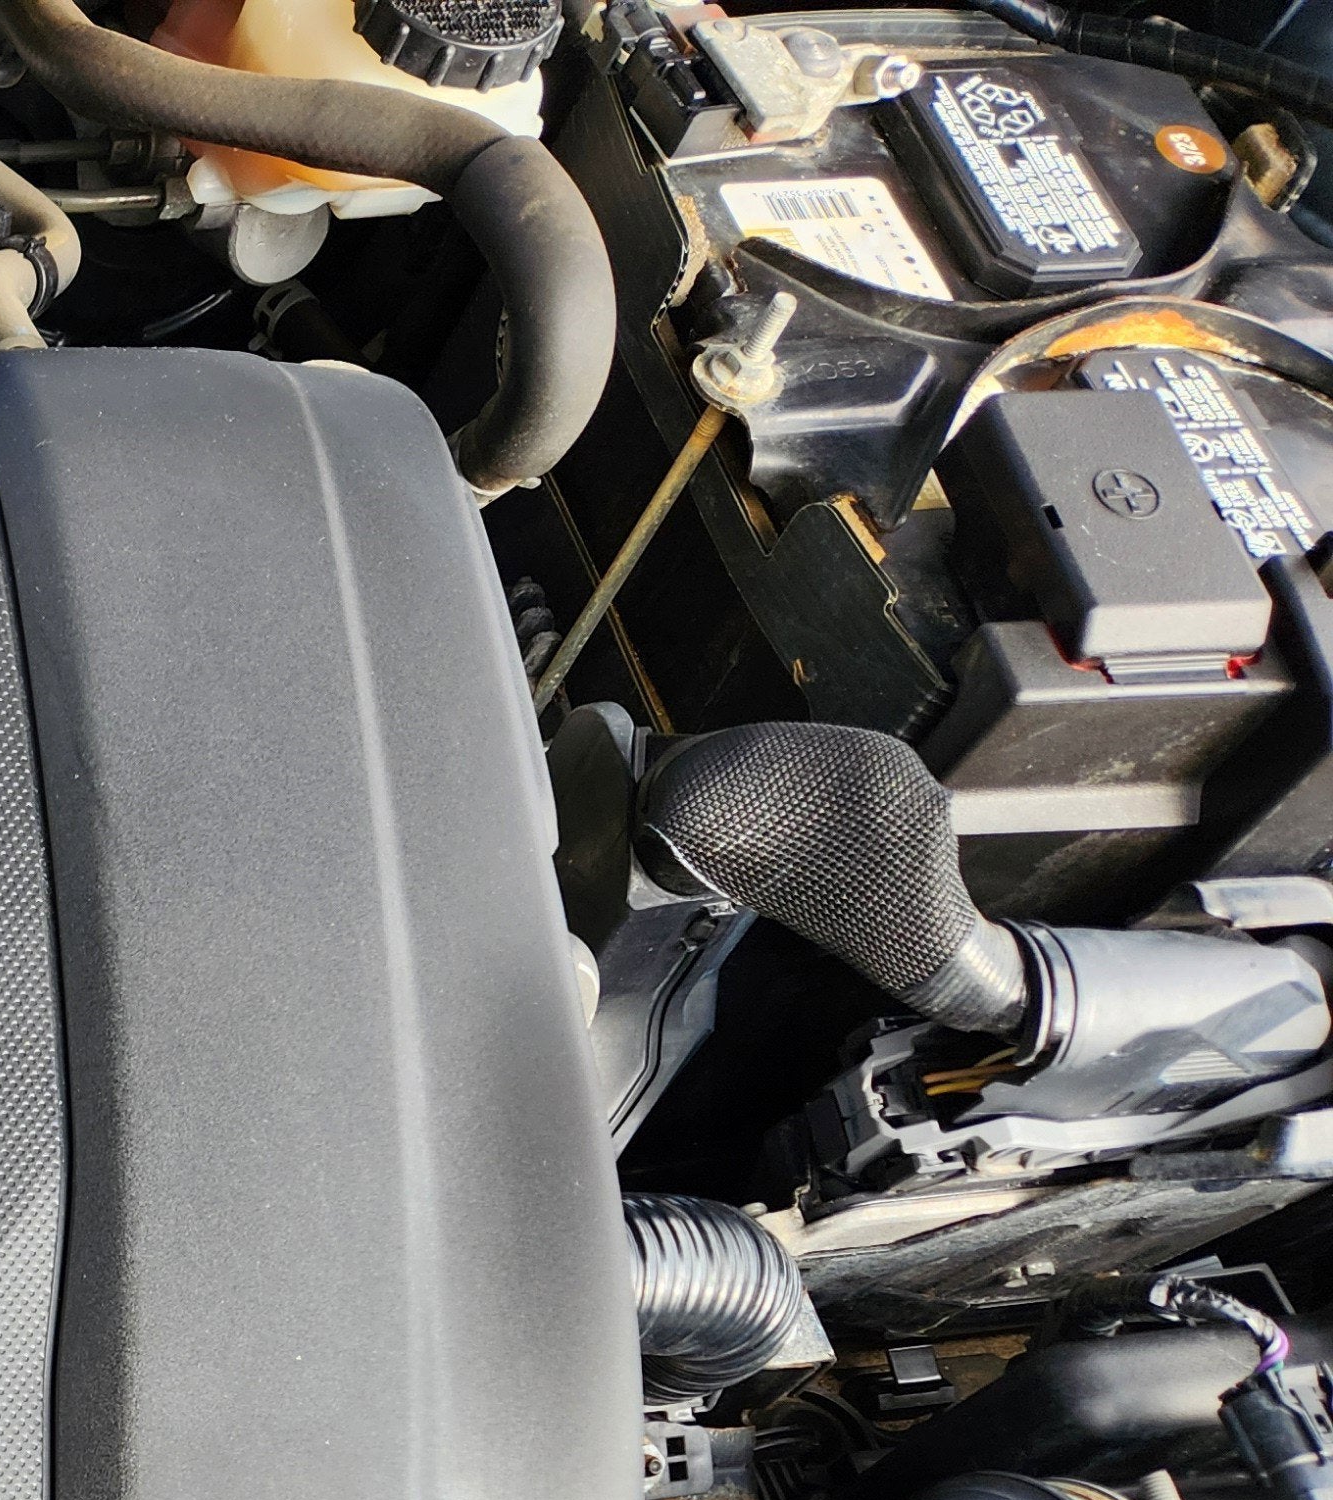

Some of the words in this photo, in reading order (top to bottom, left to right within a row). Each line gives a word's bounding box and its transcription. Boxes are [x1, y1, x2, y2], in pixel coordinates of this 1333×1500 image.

[1169, 133, 1206, 167] 3/23
[1209, 439, 1229, 457] NO
[1221, 482, 1245, 506] EYES
